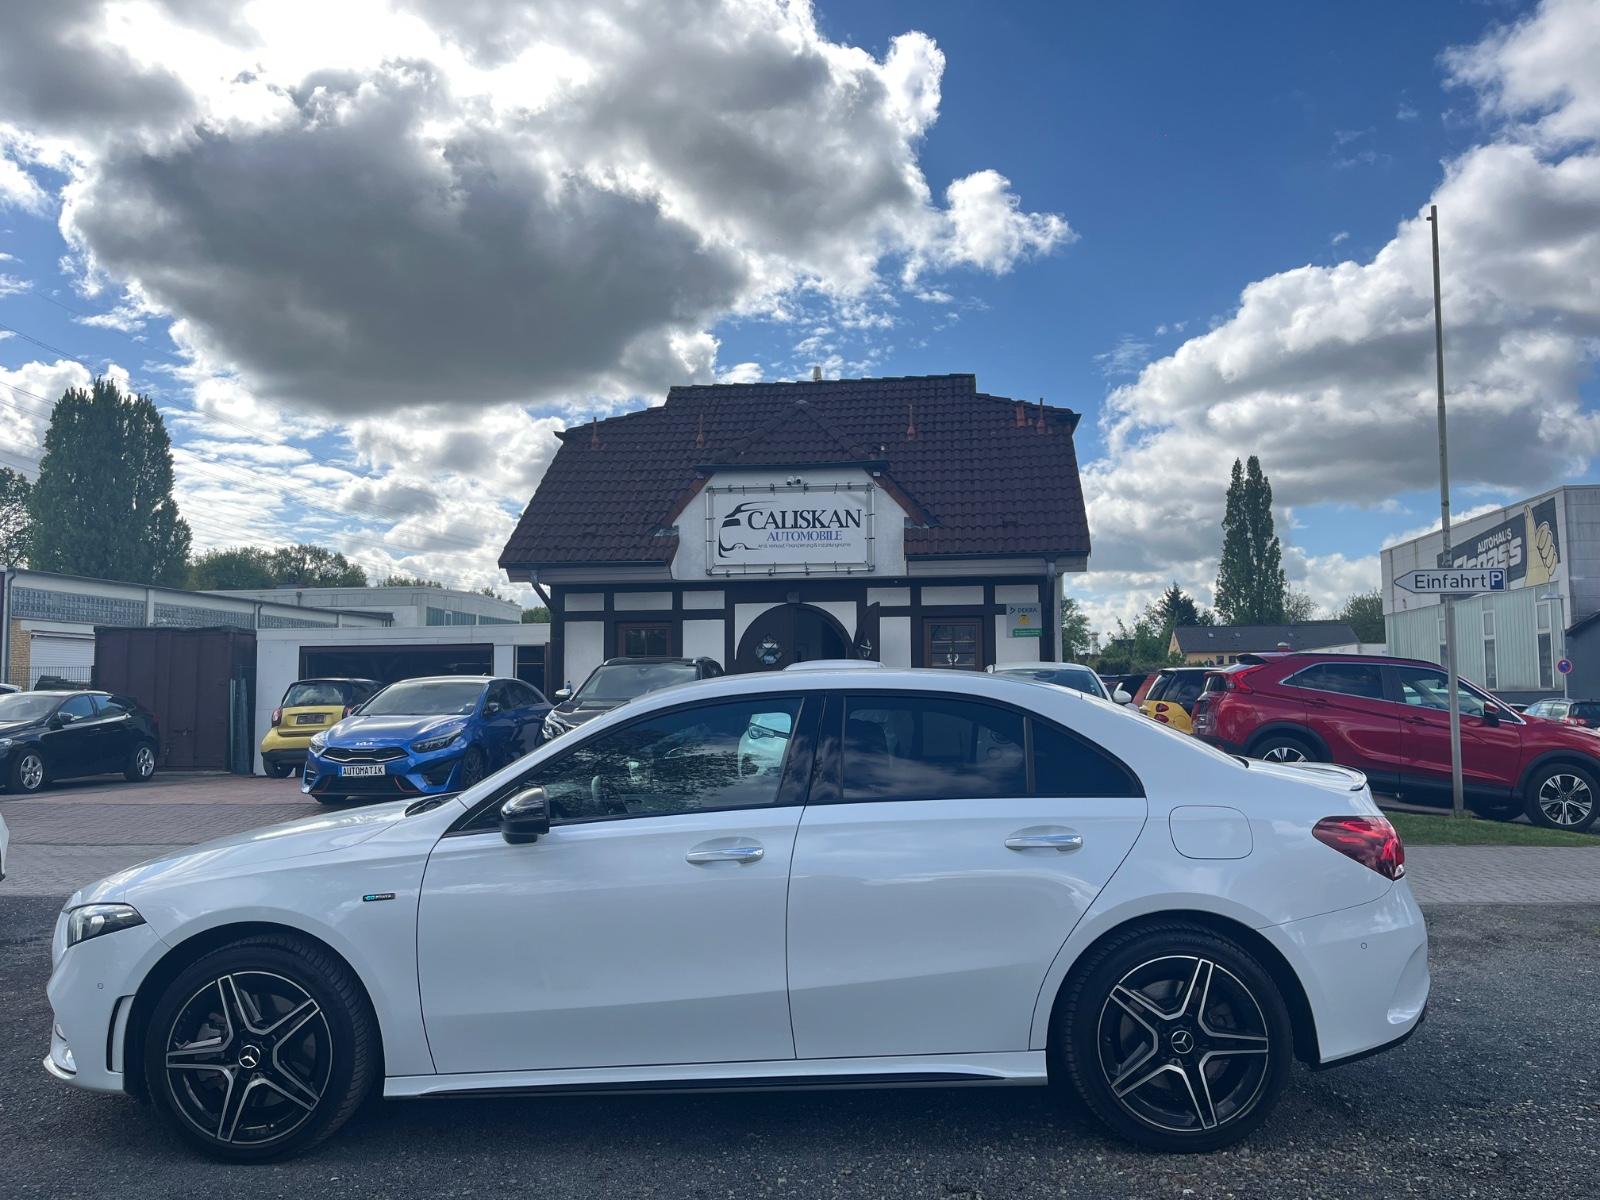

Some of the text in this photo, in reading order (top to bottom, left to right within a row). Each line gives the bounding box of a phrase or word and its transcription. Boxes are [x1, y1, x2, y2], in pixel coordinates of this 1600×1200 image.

[747, 508, 862, 530] CALISKAN
[766, 530, 843, 542] AUTOMOBILE
[1477, 527, 1513, 553] AUTOHAUS
[1414, 572, 1503, 589] Einfahrt P
[342, 766, 383, 776] AUTOMATIK
